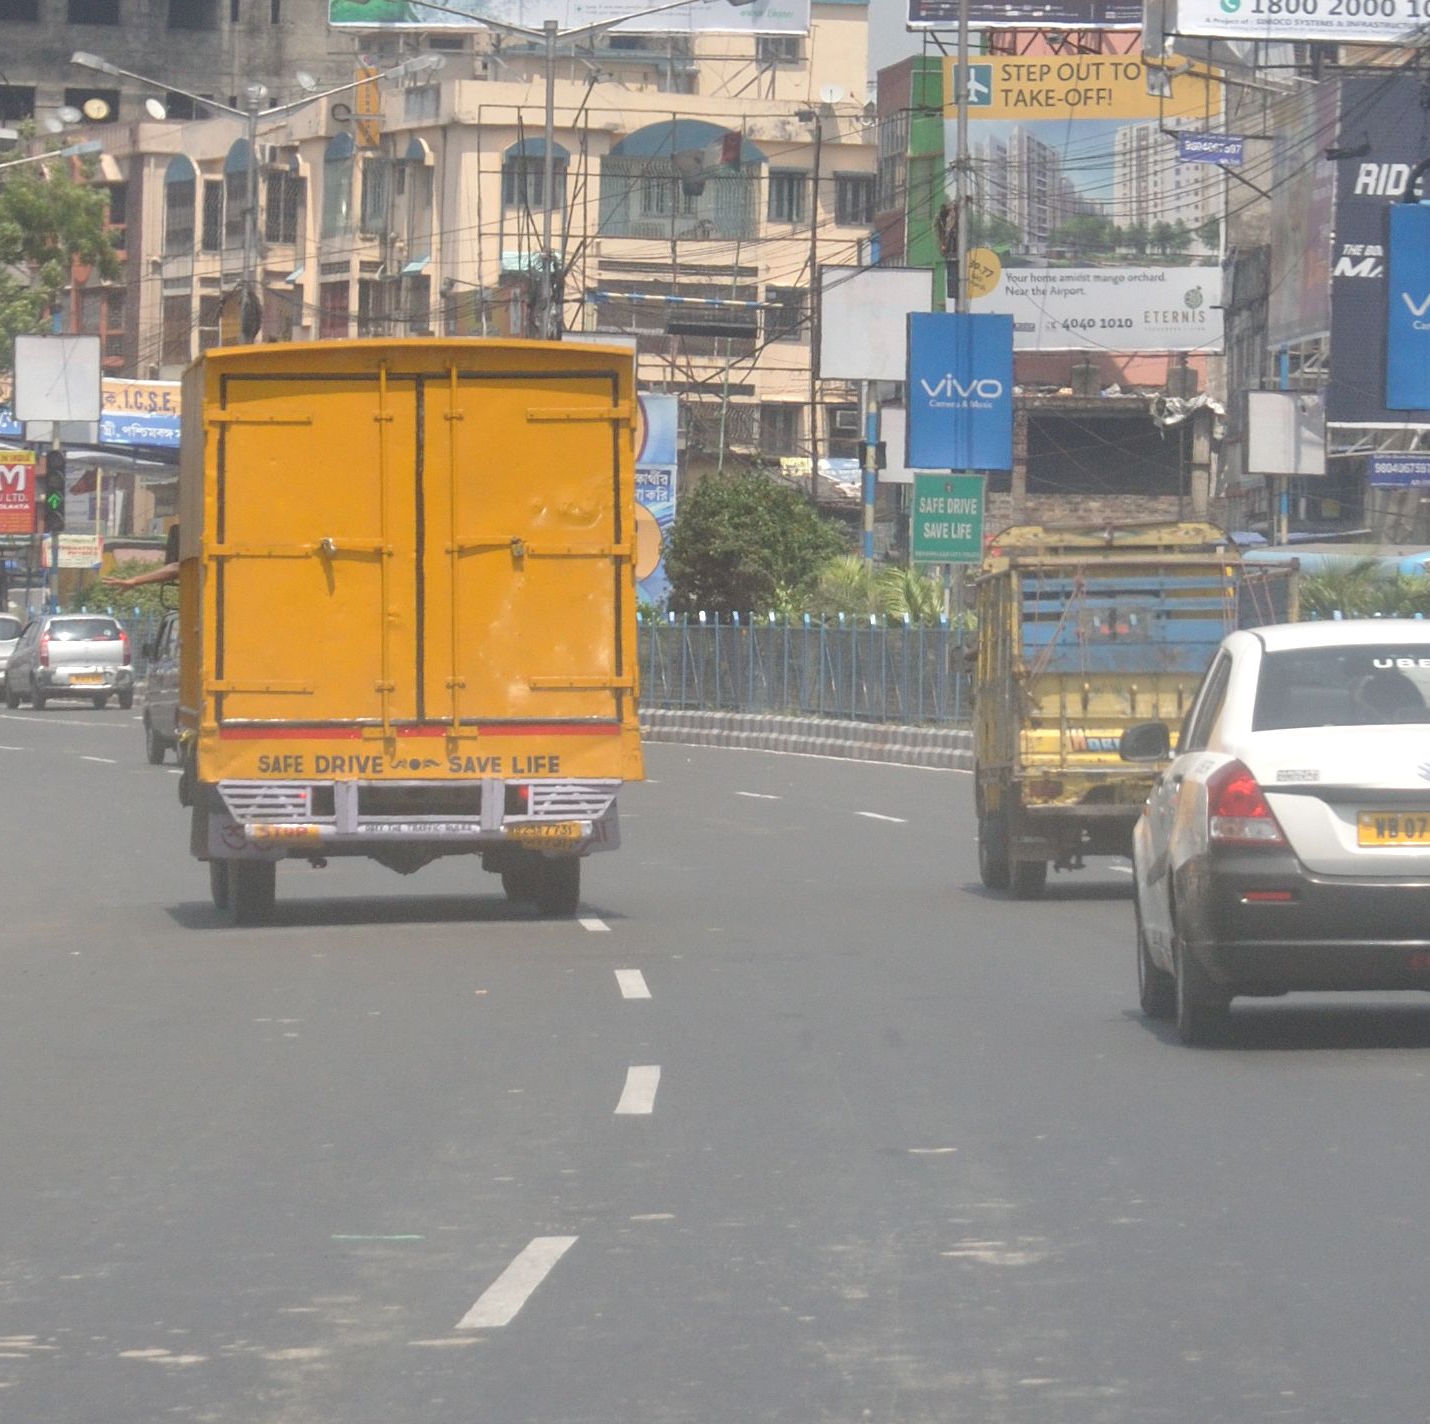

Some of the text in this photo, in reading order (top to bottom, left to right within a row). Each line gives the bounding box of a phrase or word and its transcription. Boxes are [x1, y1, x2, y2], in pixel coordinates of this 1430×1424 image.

[1001, 62, 1141, 82] STEP OUT TO
[1000, 87, 1113, 107] TAKE-OFF!
[1342, 244, 1362, 256] THE
[1005, 273, 1027, 283] Your
[1030, 273, 1058, 283] home
[1059, 273, 1091, 283] amidst
[1093, 274, 1126, 285] mango
[1005, 286, 1029, 296] Near
[1031, 286, 1048, 296] the
[1062, 318, 1097, 331] 4040
[1100, 318, 1133, 329] 1010
[1143, 311, 1206, 325] ETERNIS
[920, 374, 1004, 399] vivo
[123, 390, 176, 413] I.C.S.E,
[919, 497, 978, 515] SAFE DRIVE
[923, 522, 972, 539] SAVE LIFE
[258, 754, 561, 774] SAFE DRIVE SAVE LIFE
